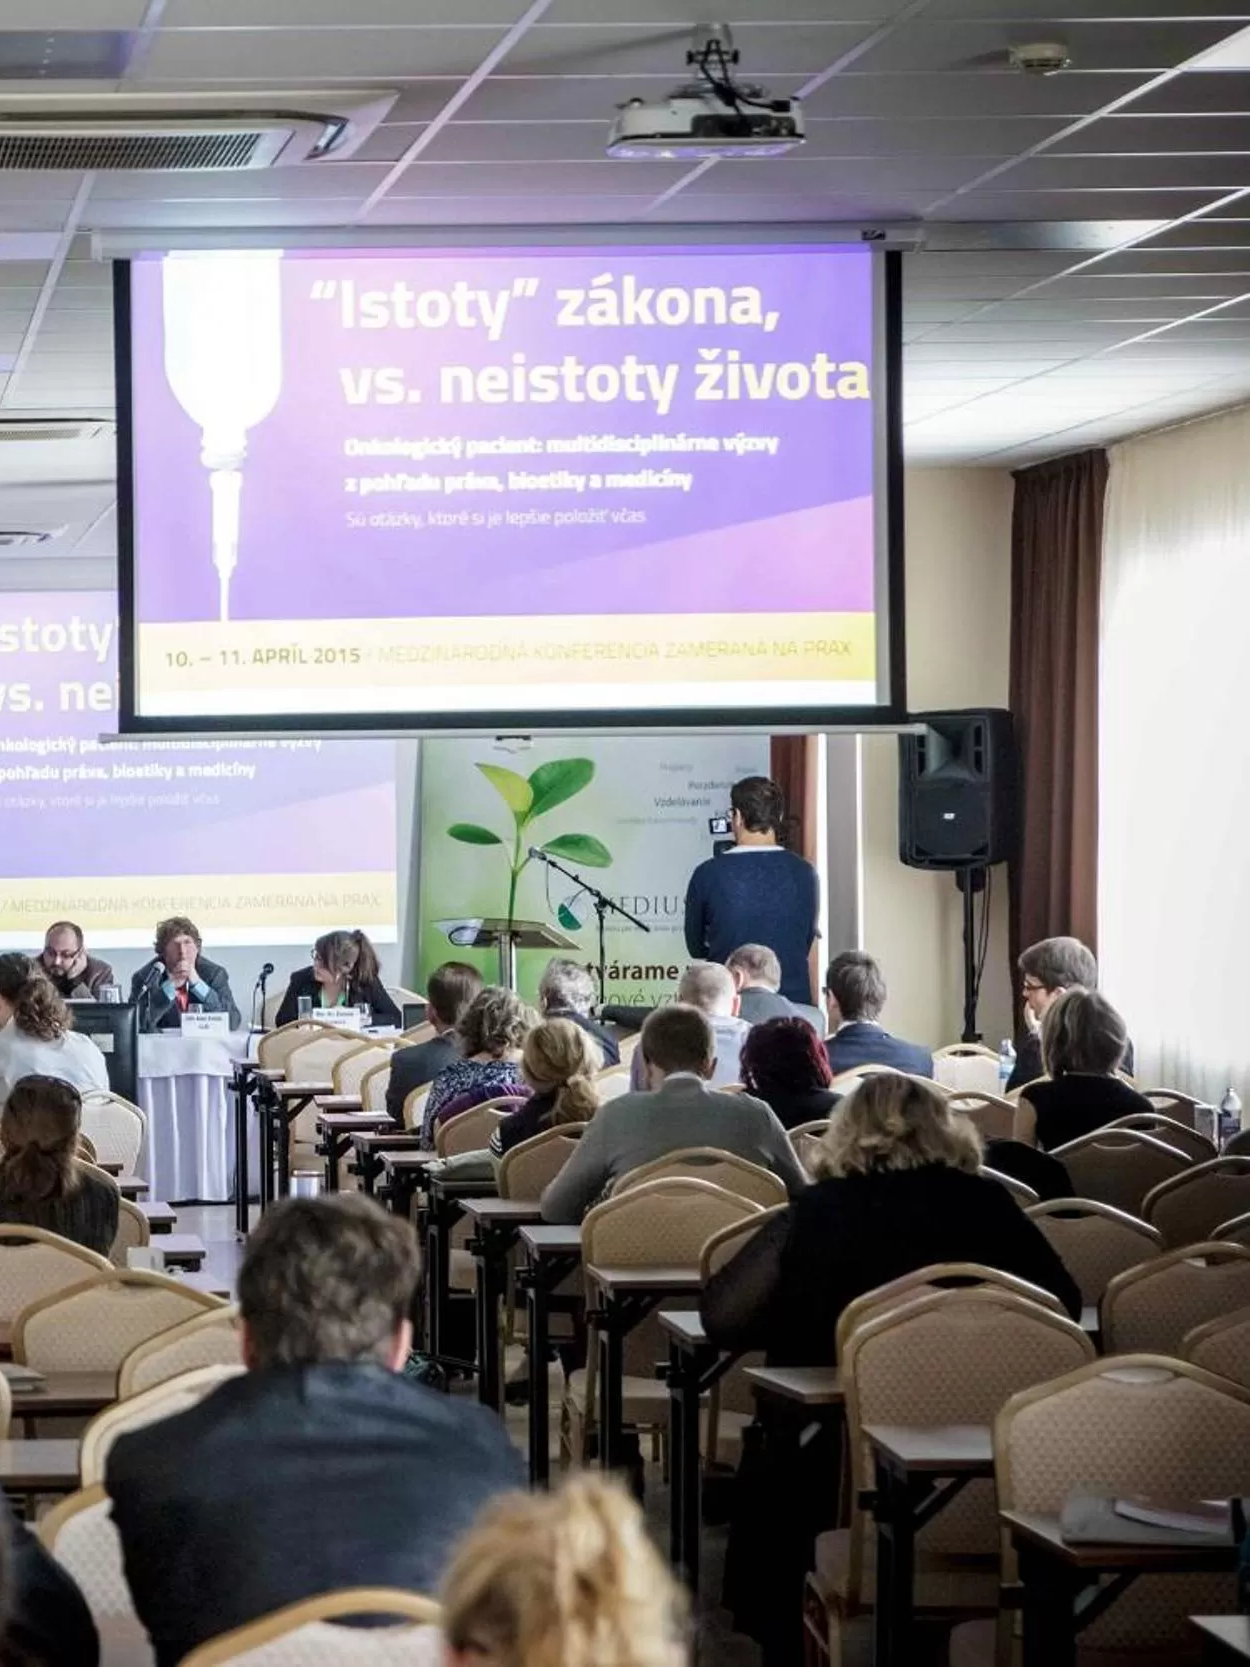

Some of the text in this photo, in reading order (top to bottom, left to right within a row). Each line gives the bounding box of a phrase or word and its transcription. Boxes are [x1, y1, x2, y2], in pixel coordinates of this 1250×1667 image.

[555, 272, 780, 333] zákona,
[338, 347, 871, 416] vs. neistoty života
[589, 474, 602, 489] a
[165, 650, 194, 668] 10.
[219, 650, 246, 666] 11.
[252, 642, 308, 665] APRÍL
[313, 647, 362, 664] 2015
